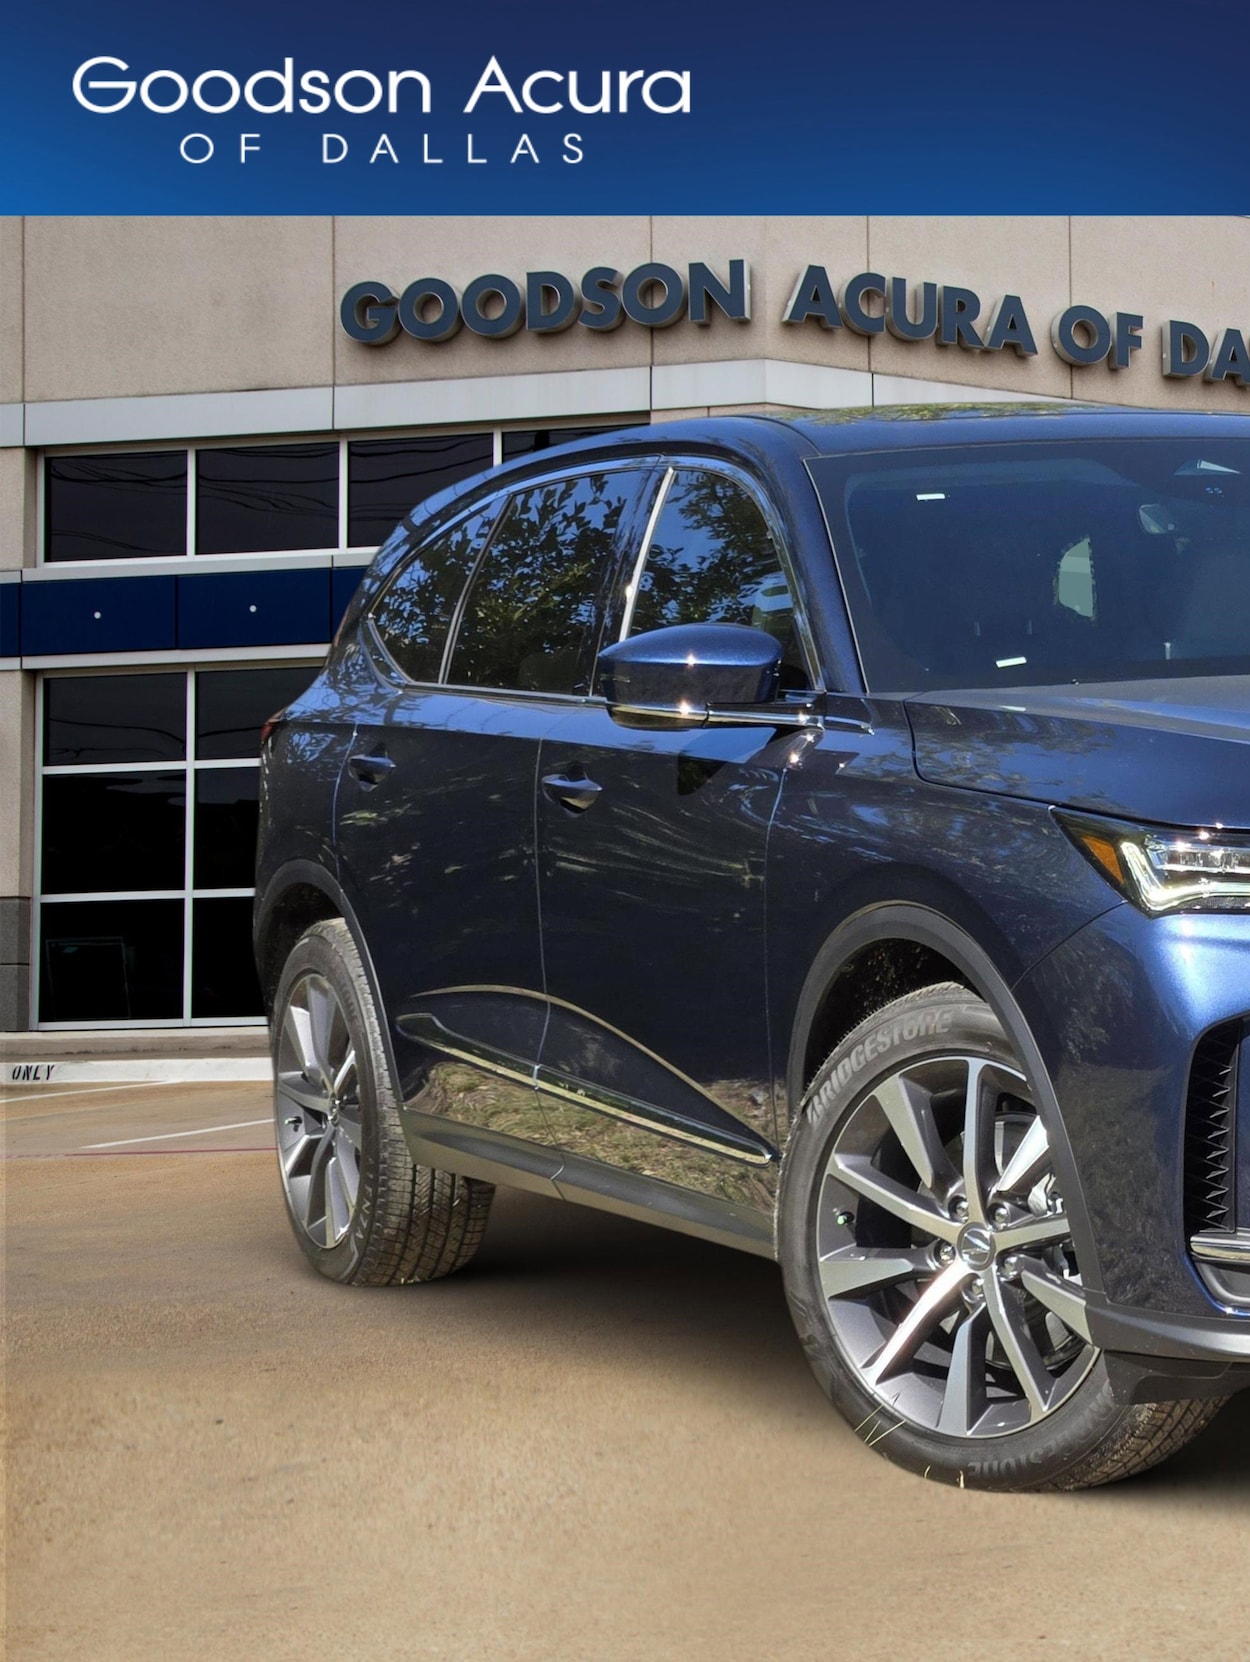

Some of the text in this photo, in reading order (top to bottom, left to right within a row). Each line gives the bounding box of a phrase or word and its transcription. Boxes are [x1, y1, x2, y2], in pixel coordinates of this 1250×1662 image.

[340, 258, 750, 345] GOODSON
[783, 265, 1038, 356] ACURA
[1052, 304, 1143, 370] OF
[12, 1064, 55, 1081] ONLY
[805, 1008, 953, 1125] BRIDGESTONE
